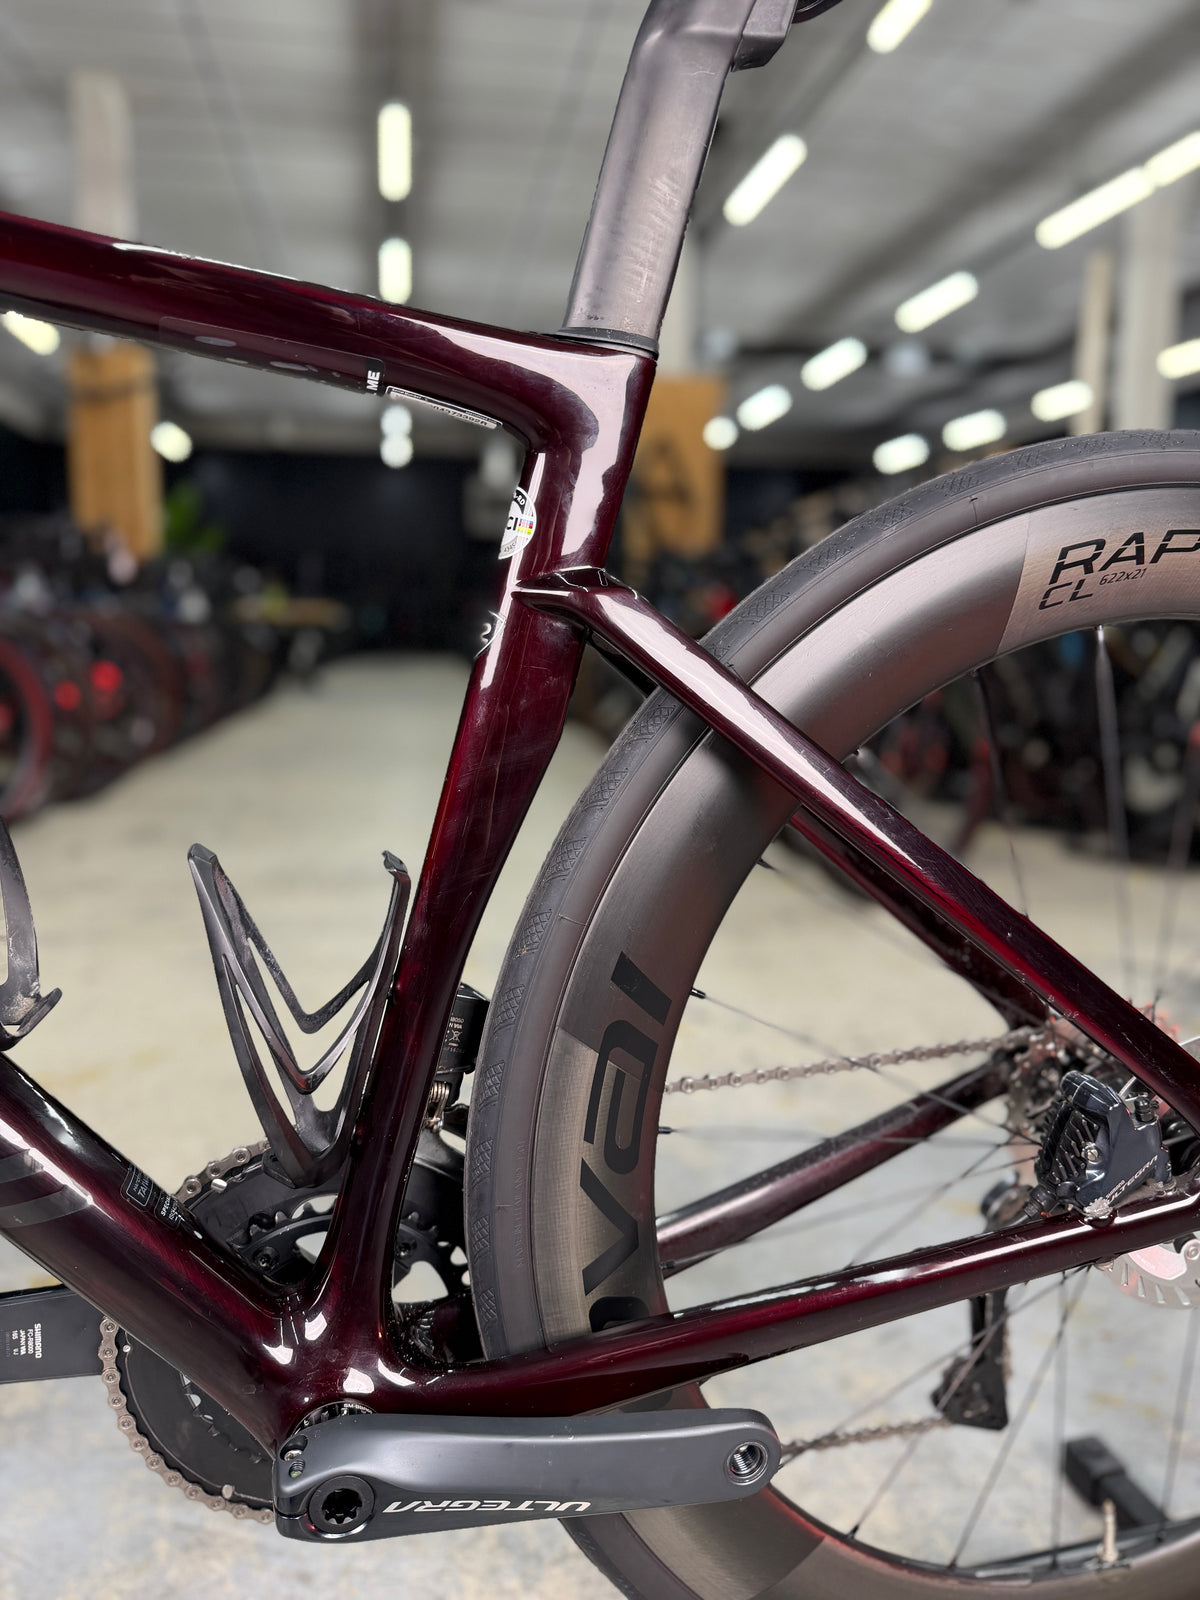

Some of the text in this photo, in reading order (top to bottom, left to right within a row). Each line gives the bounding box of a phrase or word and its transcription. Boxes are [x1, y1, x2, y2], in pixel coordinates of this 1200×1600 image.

[365, 370, 381, 392] ME
[1048, 529, 1200, 586] RAP
[1099, 567, 1148, 586] 622x21
[1038, 578, 1094, 611] CL
[34, 1323, 42, 1359] SHIMANO
[382, 1499, 592, 1514] ULTEGRA
